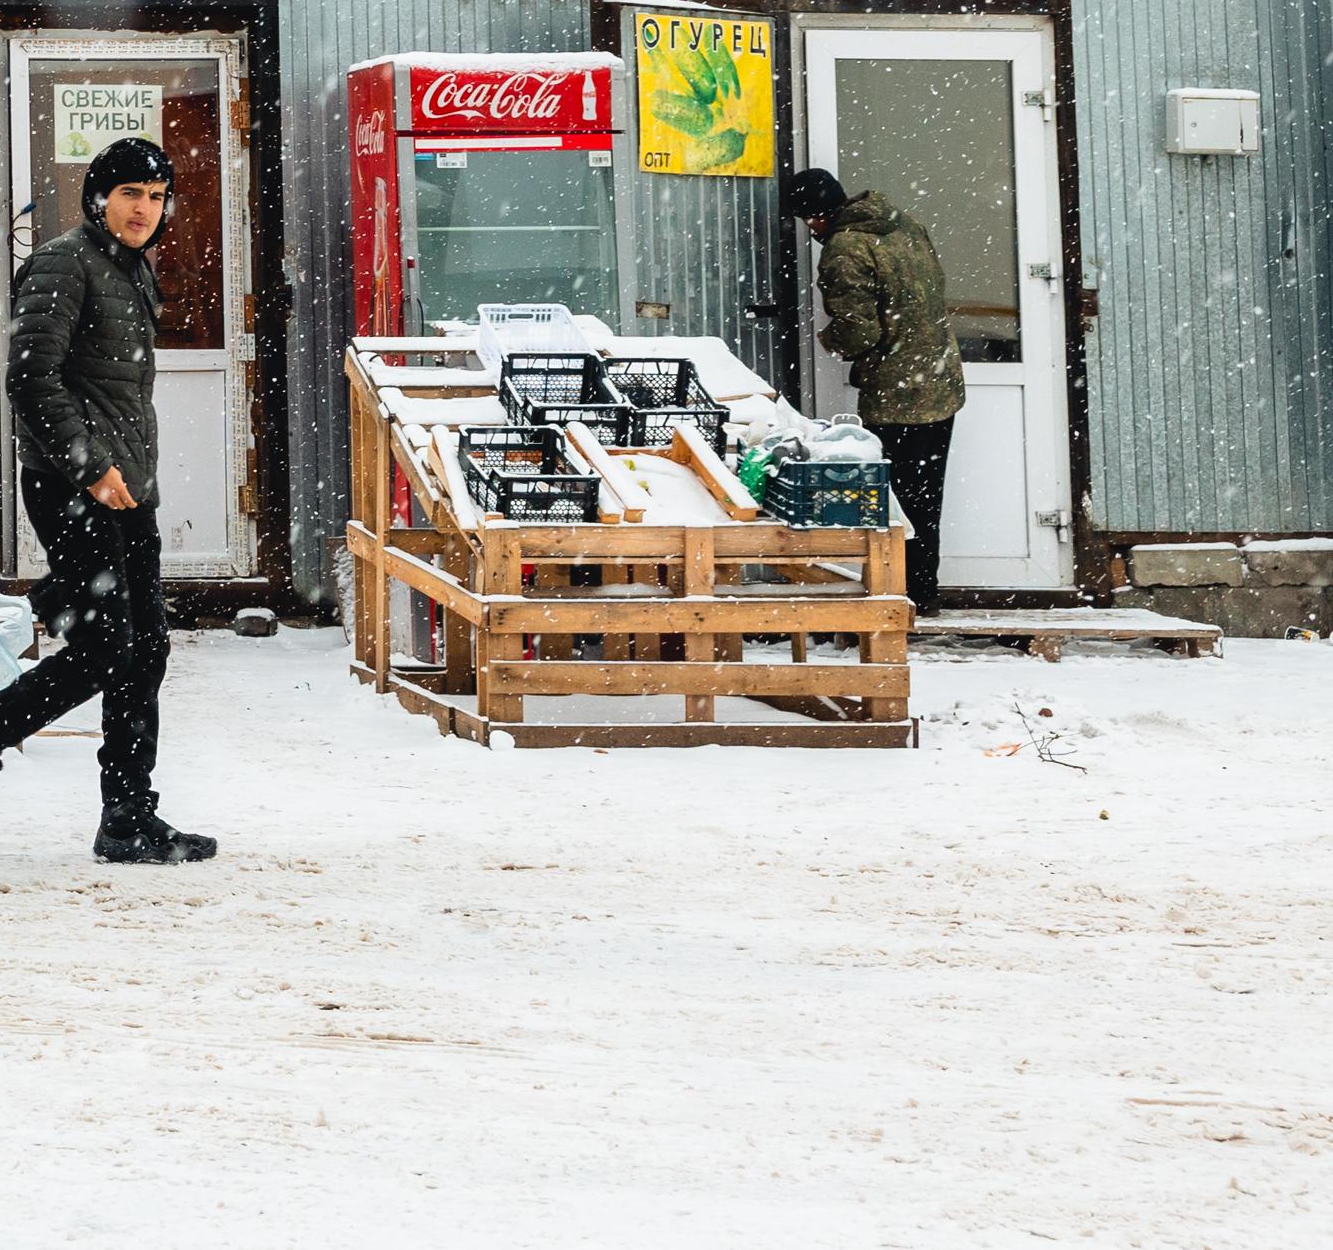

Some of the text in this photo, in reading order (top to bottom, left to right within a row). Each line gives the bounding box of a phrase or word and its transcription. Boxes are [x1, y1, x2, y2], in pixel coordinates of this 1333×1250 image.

[641, 18, 767, 58] ОГУРЕЦ
[61, 89, 154, 109] СВЕЖИЕ
[421, 72, 566, 119] Coca-Cola
[69, 112, 145, 131] ГРИБЫ
[644, 152, 671, 168] ОПТ
